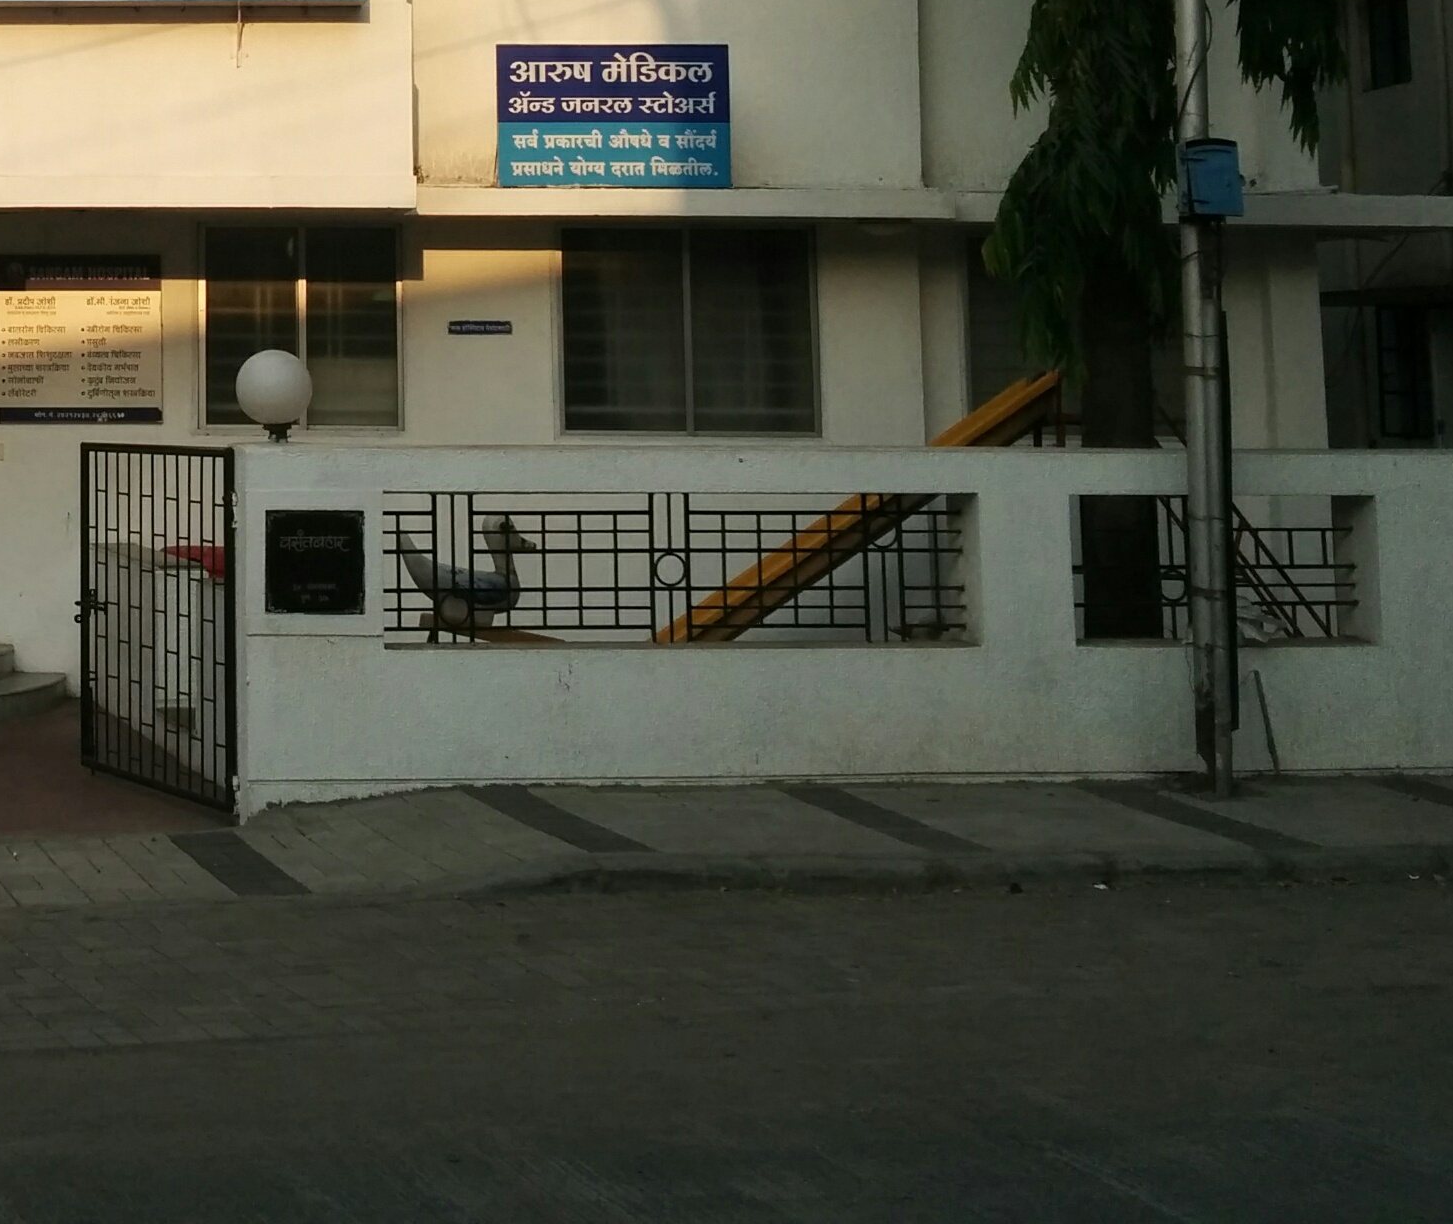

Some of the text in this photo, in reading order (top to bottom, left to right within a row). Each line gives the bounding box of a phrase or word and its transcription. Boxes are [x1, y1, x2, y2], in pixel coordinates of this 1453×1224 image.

[509, 51, 713, 83] आरुष मेडिकल
[561, 97, 632, 114] जनरल
[638, 91, 716, 114] स्टोअर्स
[512, 128, 717, 150] सर्व प्रकारची औषधे व सौंदर्य
[511, 156, 564, 176] प्रसाधने
[569, 156, 606, 176] योग्य
[610, 161, 645, 177] दरात
